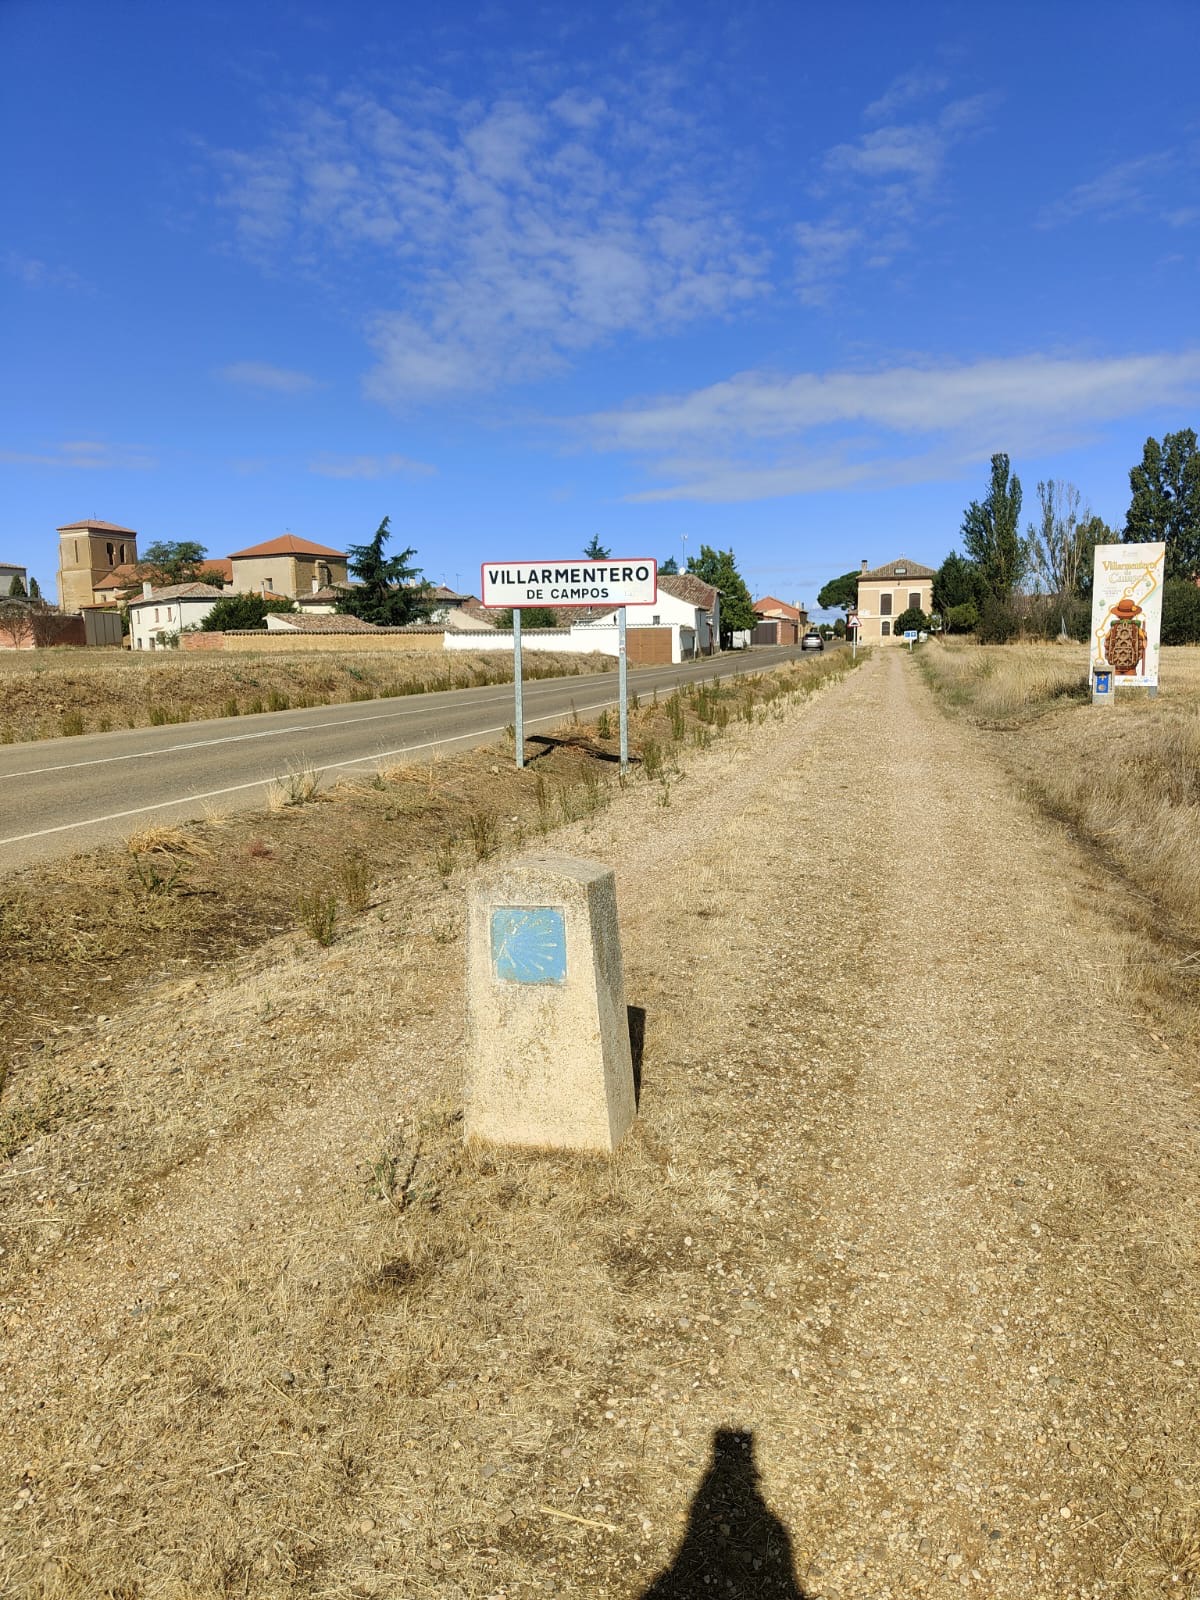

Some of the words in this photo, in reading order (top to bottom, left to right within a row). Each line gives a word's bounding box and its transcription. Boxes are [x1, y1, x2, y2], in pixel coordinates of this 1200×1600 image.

[488, 566, 649, 584] VILLARMENTERO
[526, 589, 544, 600] DE
[550, 588, 609, 599] CAMPOS
